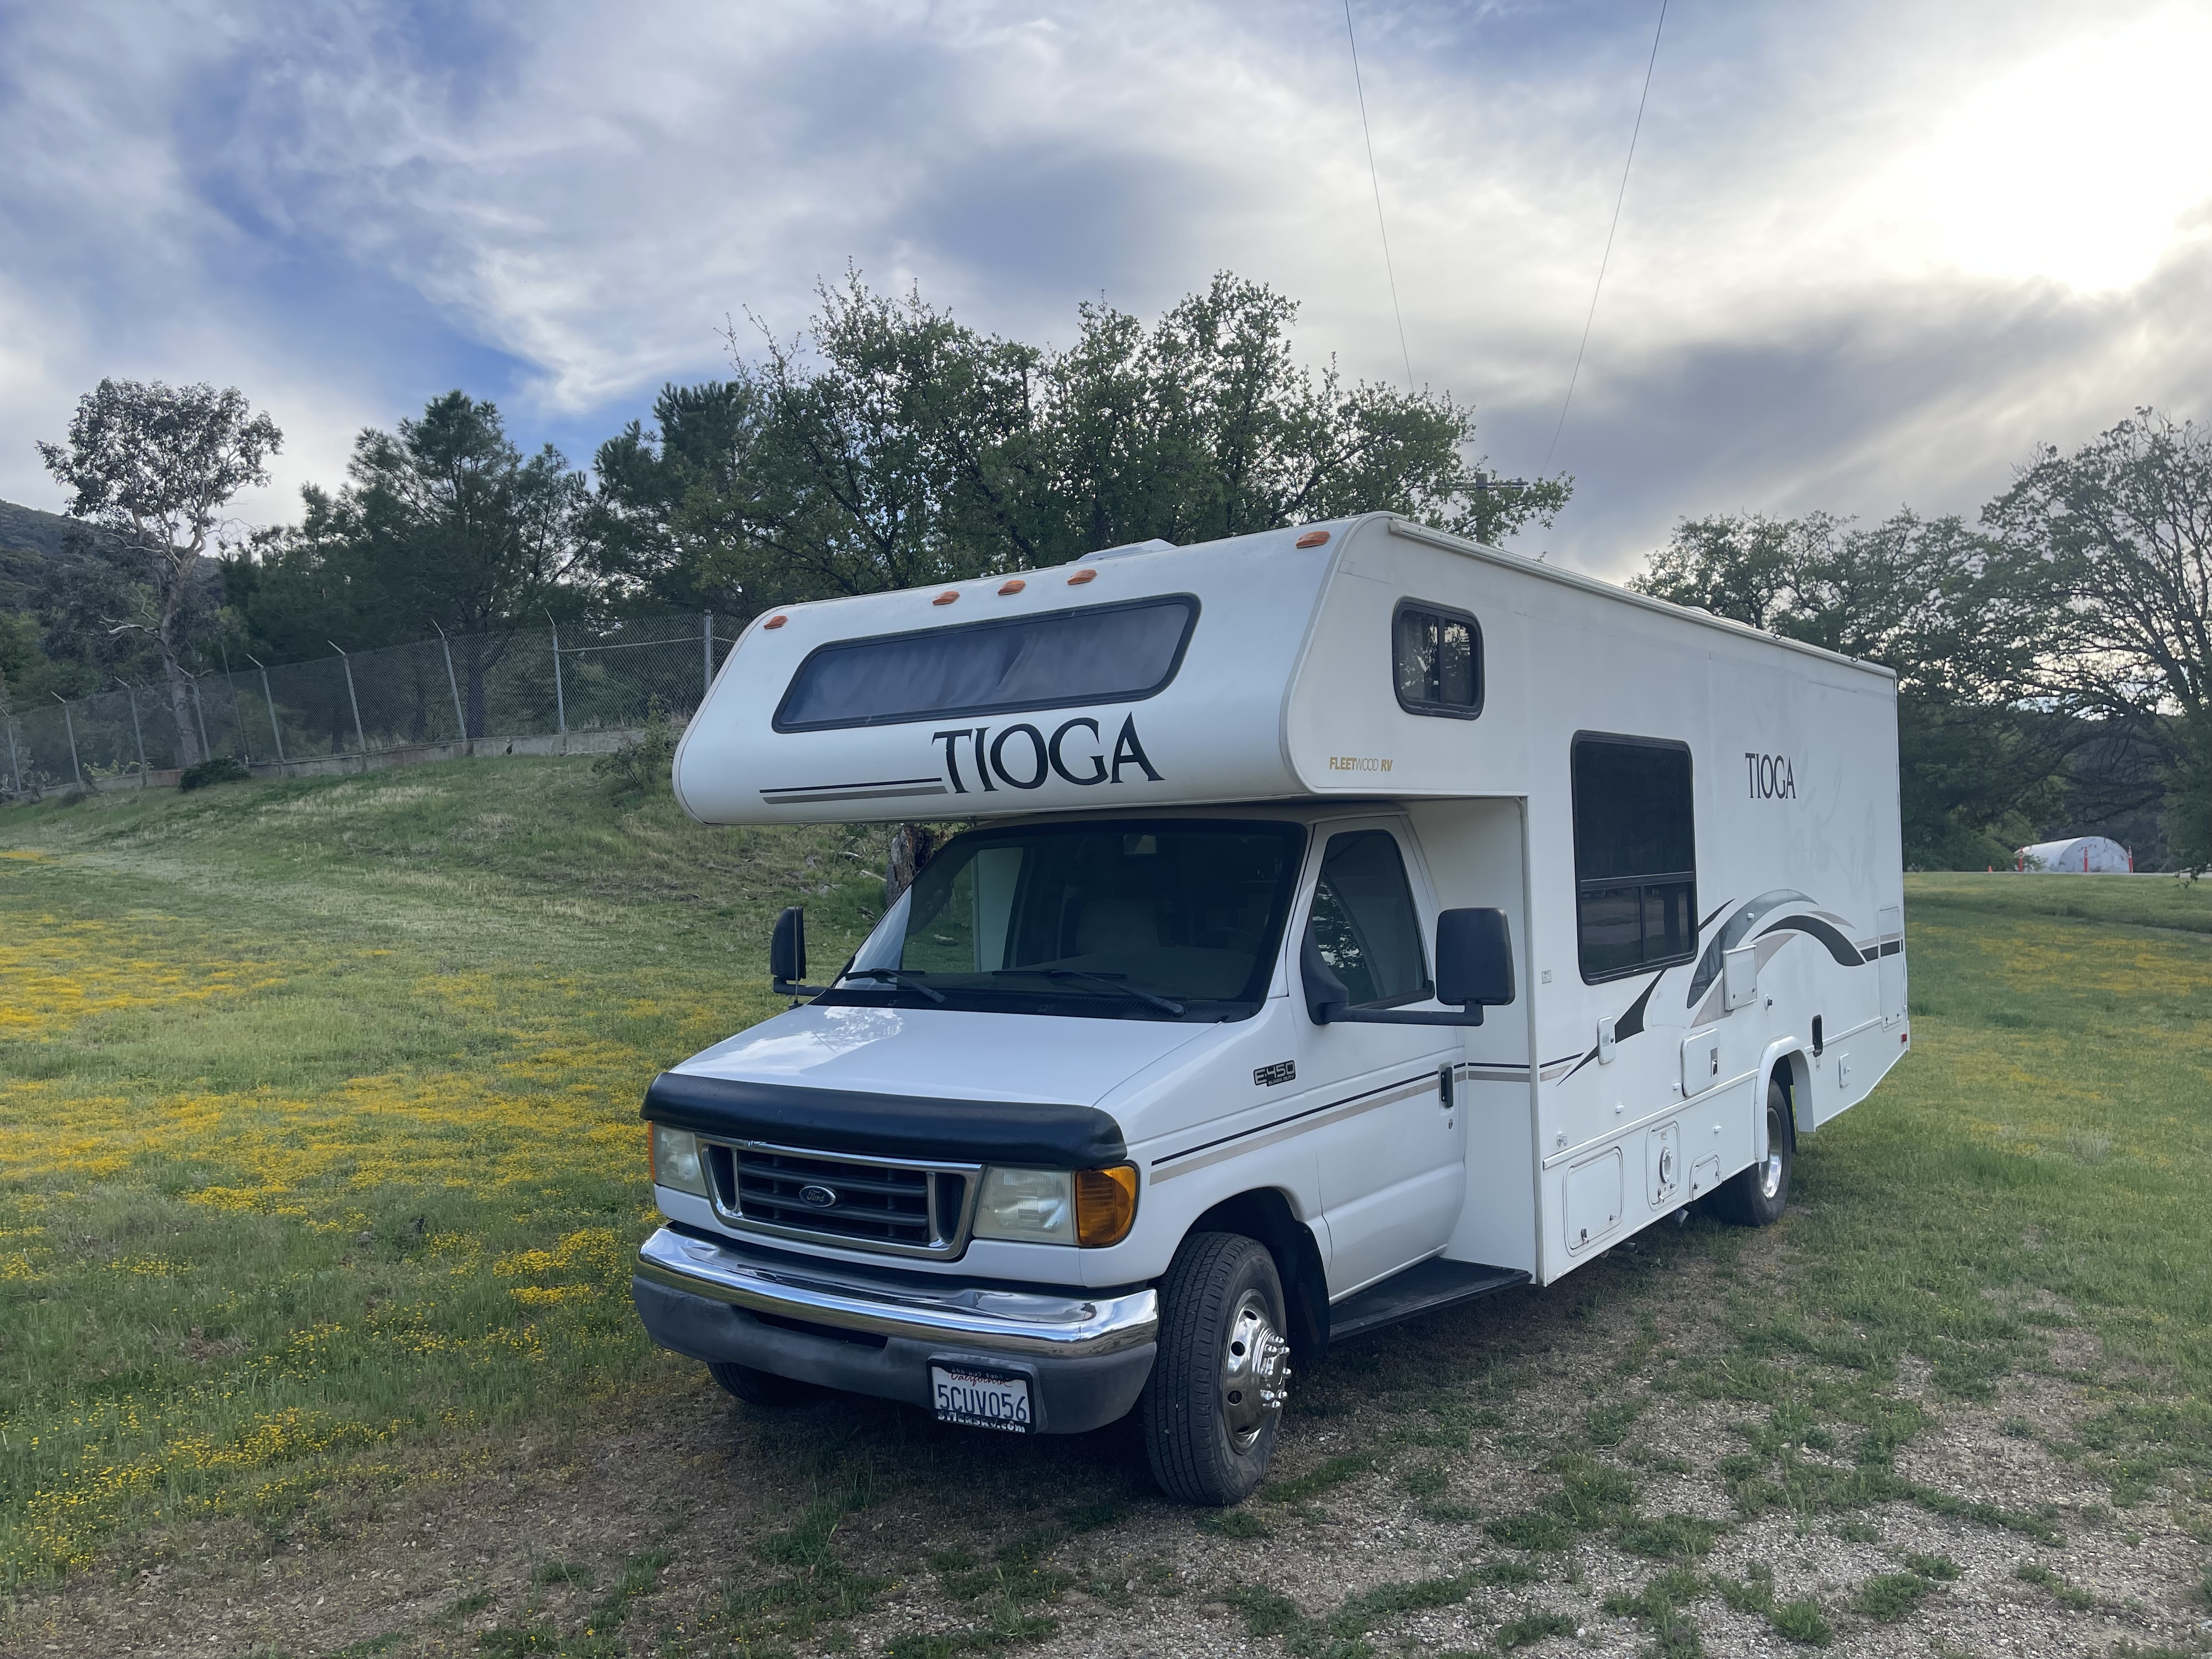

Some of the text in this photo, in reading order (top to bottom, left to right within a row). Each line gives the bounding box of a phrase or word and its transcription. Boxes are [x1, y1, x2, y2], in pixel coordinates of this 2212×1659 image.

[932, 711, 1166, 793] TIOGA
[1330, 757, 1393, 771] FLEETWOOD RV
[1745, 752, 1796, 799] TIOGA
[806, 1189, 825, 1202] Ford
[938, 1384, 1027, 1422] 5CUV056
